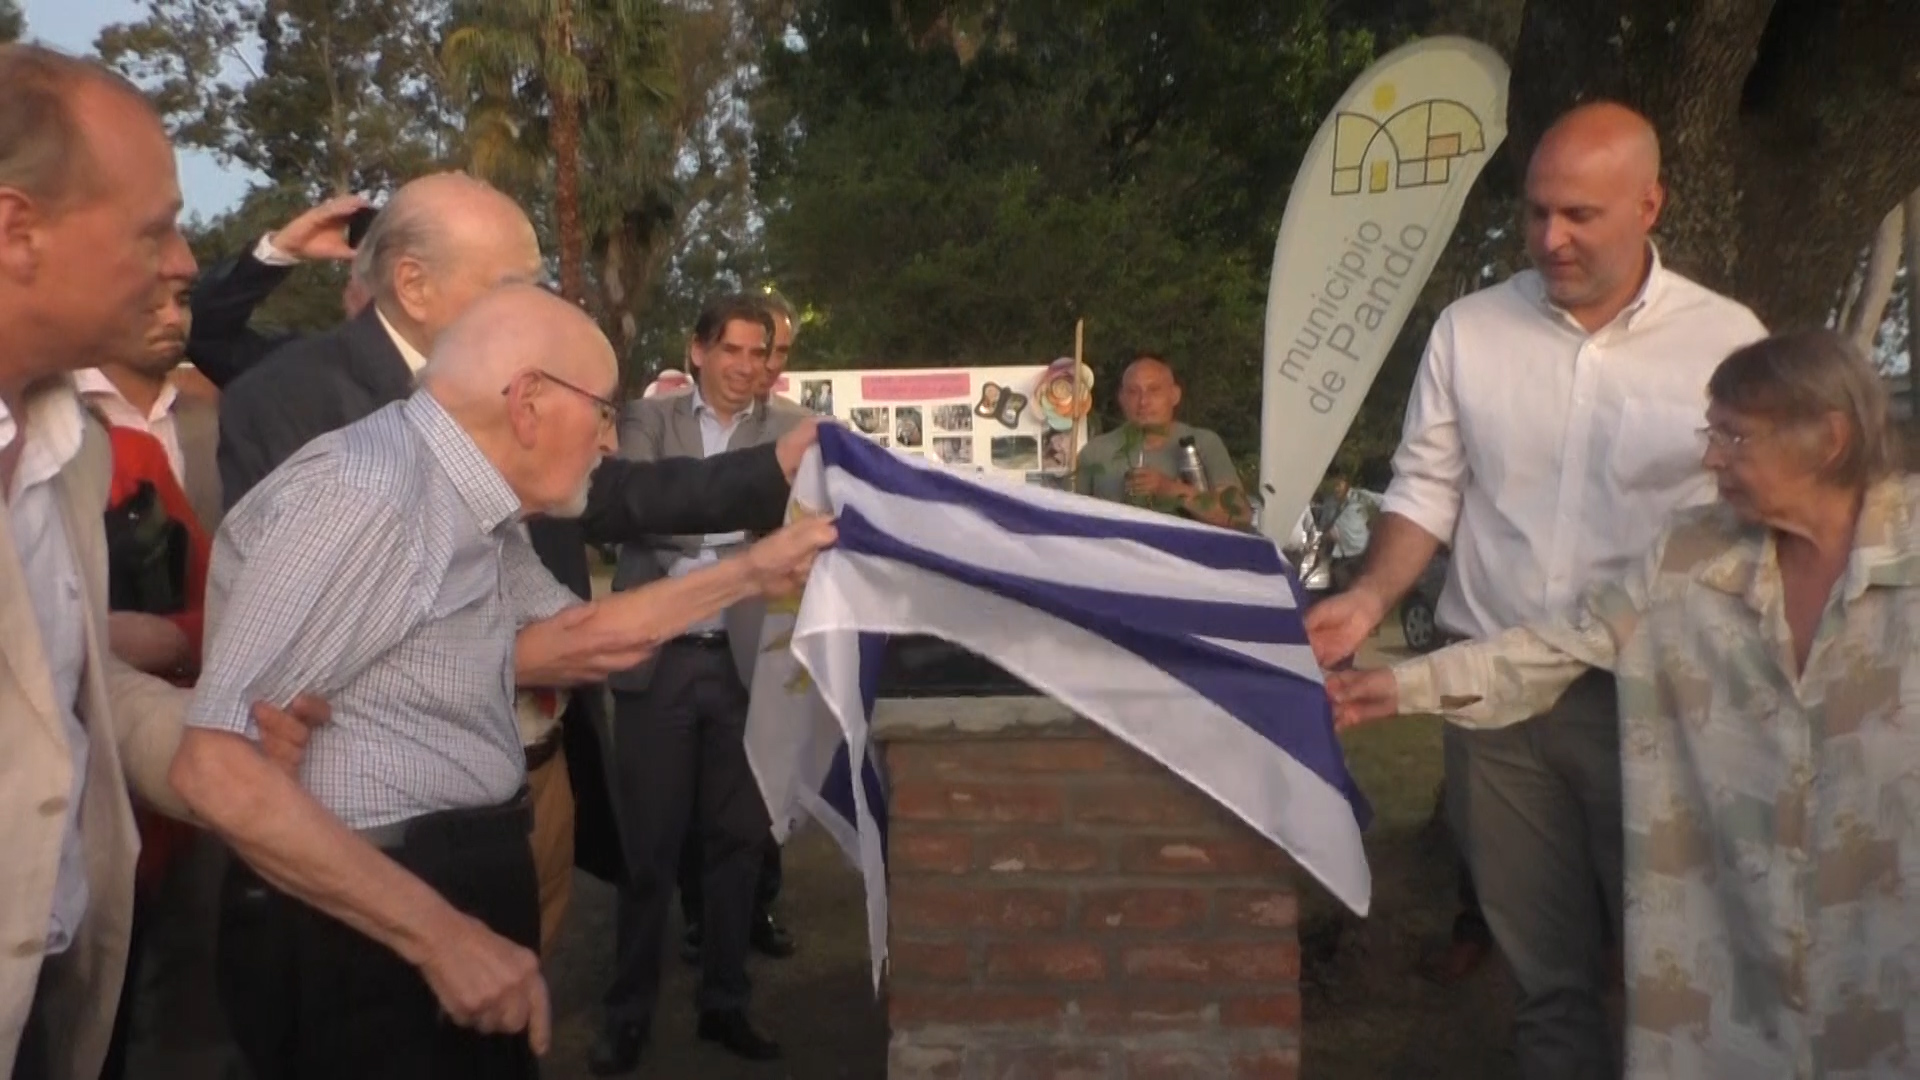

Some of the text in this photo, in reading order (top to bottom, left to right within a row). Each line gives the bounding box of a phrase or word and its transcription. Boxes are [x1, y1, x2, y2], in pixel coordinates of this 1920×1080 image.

[1278, 220, 1382, 383] municipio
[1307, 223, 1428, 414] de Pando
